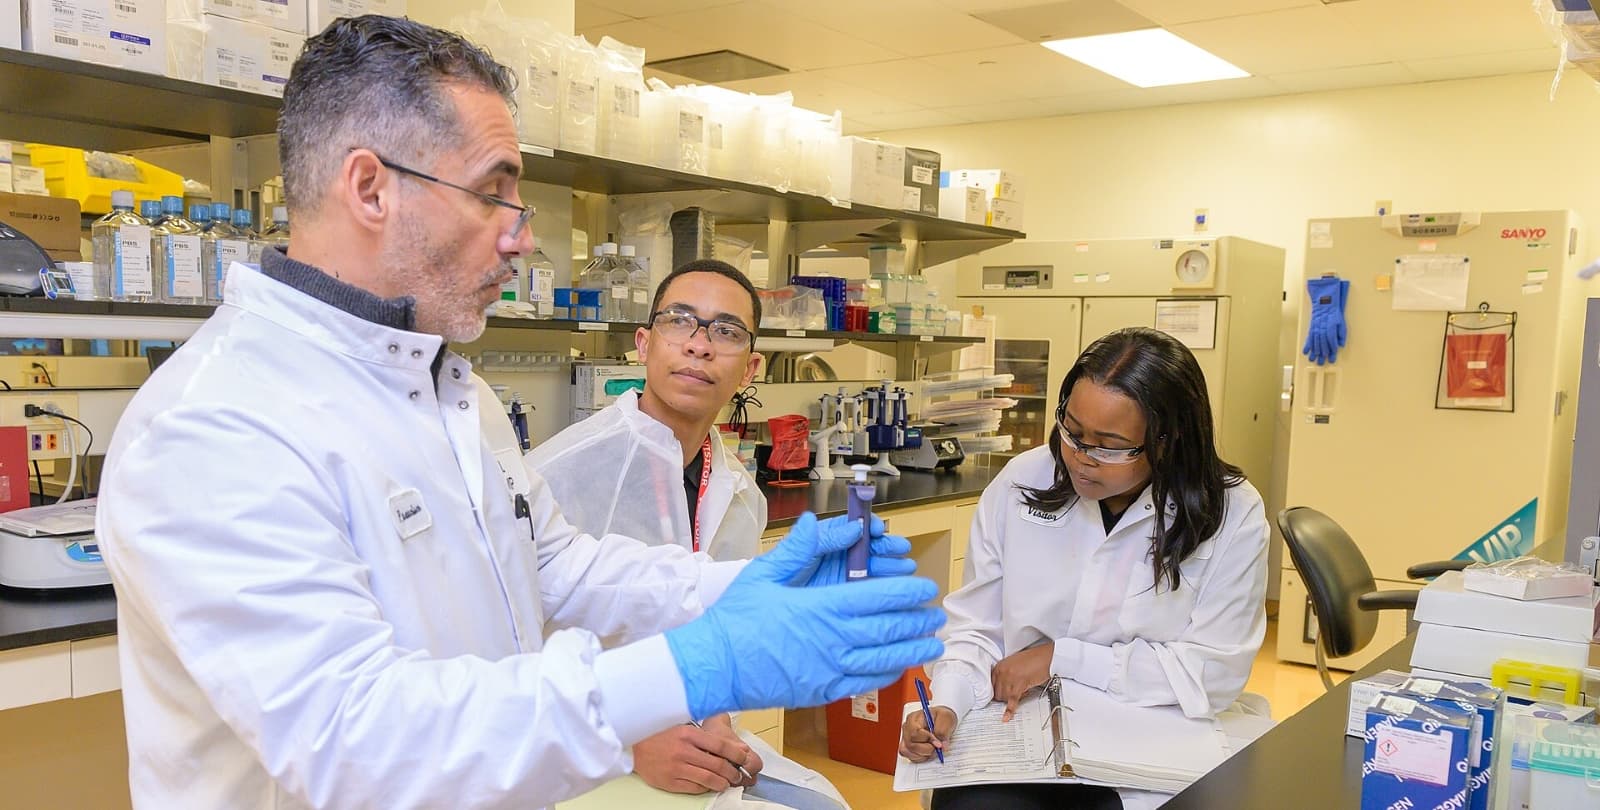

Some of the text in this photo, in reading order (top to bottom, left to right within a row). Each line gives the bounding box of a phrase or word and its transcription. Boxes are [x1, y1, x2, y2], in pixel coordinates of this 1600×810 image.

[1500, 228, 1546, 239] SANYO
[701, 439, 713, 487] VISITOR
[1467, 523, 1523, 565] VIP
